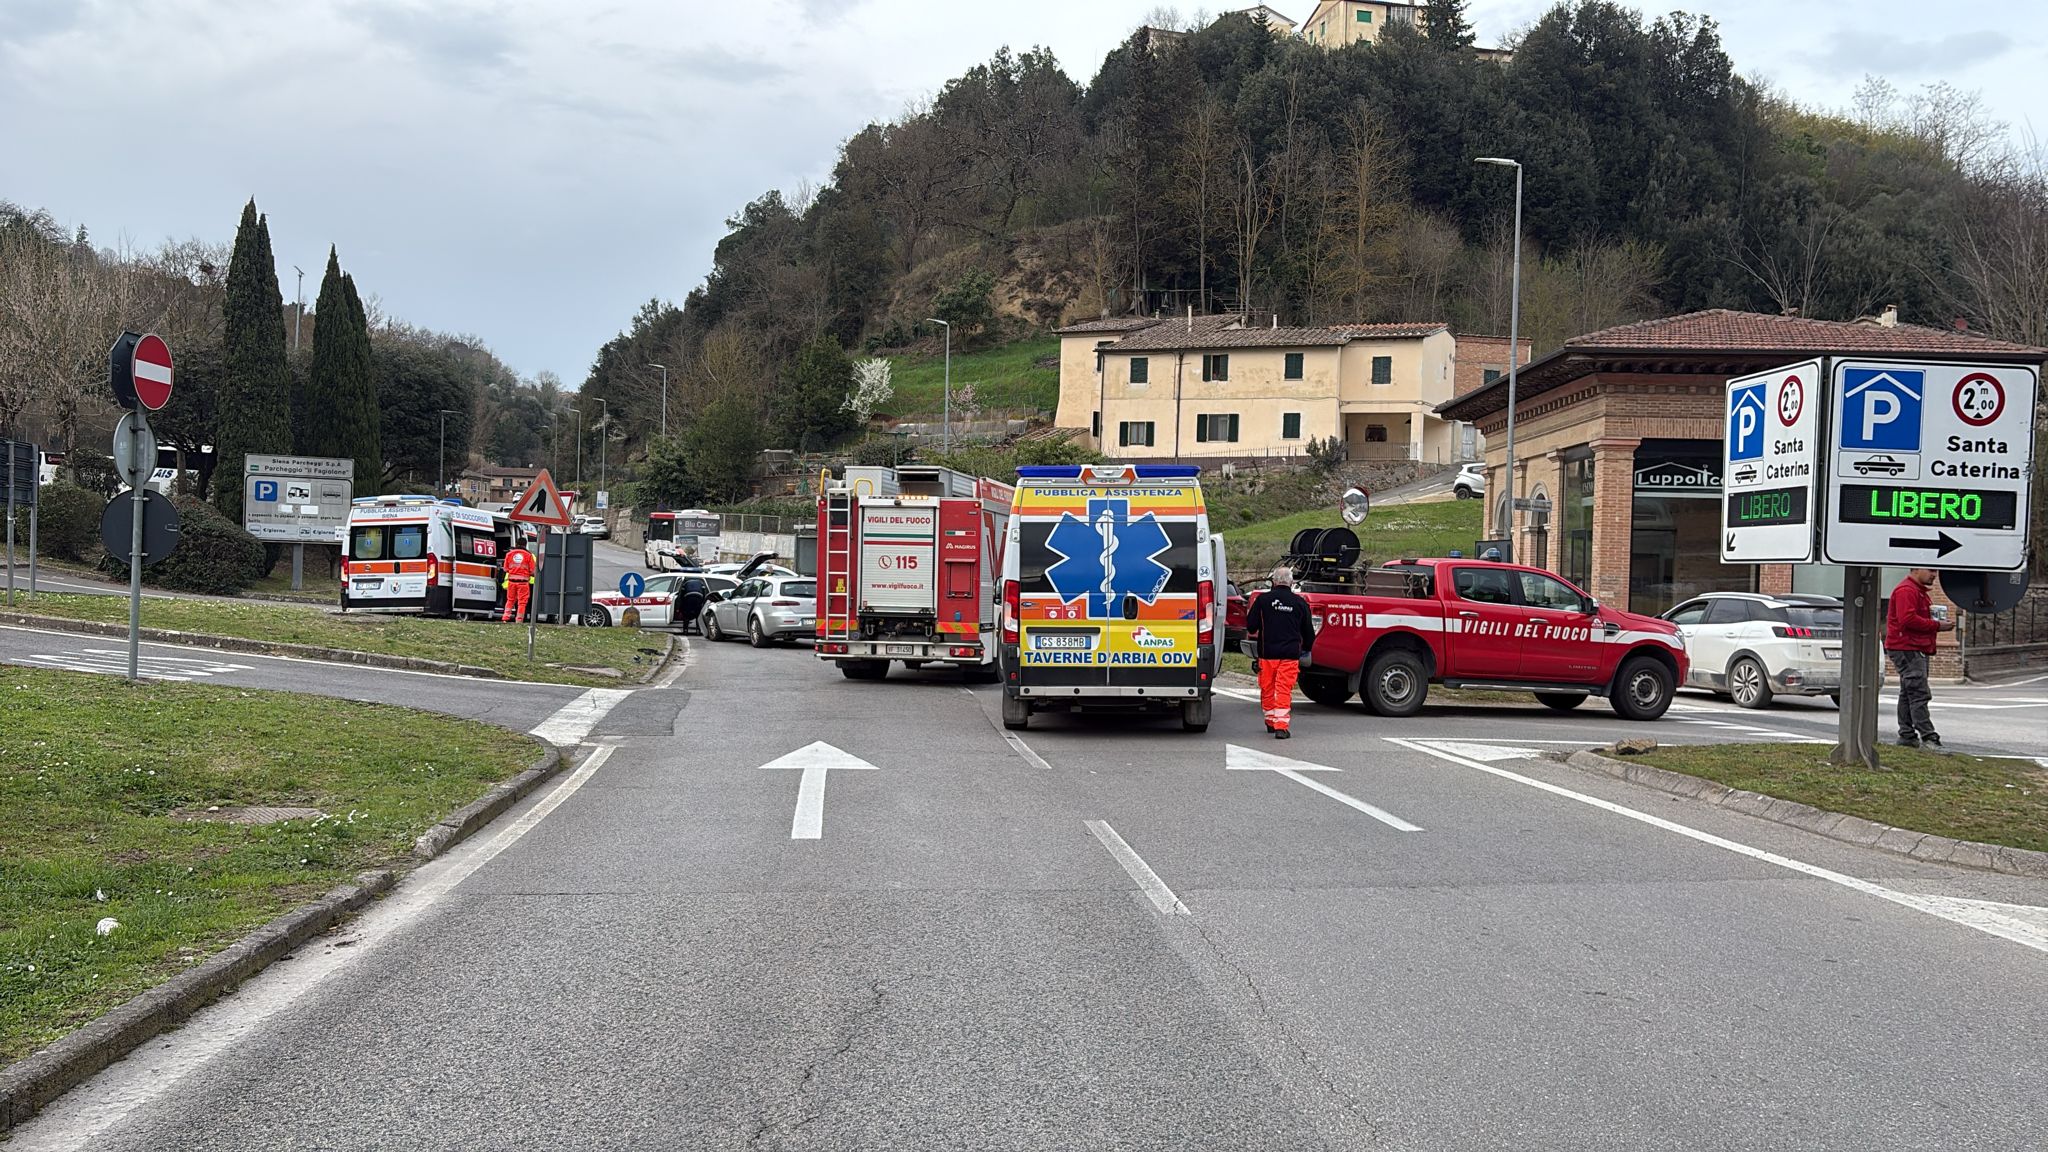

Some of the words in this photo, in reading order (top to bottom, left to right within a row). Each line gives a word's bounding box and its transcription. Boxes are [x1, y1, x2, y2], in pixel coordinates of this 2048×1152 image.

[1980, 387, 1989, 395] m
[1861, 389, 1901, 441] P
[1738, 405, 1756, 453] P
[1774, 438, 1804, 456] Santa
[1946, 435, 2008, 454] Santa
[264, 465, 303, 474] Parcheggio
[1766, 462, 1810, 480] Caterina
[1930, 460, 2020, 479] Caterina
[259, 483, 273, 499] P
[1740, 492, 1791, 520] LIBERO
[1870, 489, 1982, 521] LIBERO
[867, 516, 888, 524] VIGILI
[889, 516, 904, 524] DEL
[905, 516, 931, 525] FUOCO
[895, 555, 918, 570] 115
[1200, 568, 1209, 576] 34
[1147, 570, 1169, 603] ORION
[1341, 613, 1363, 628] 115
[1464, 619, 1510, 636] VIGILI
[1514, 623, 1539, 638] DEL
[1543, 625, 1589, 642] FUOCO
[1041, 636, 1054, 647] GS
[1024, 652, 1093, 664] TAVERNE
[1097, 652, 1159, 665] D'ARBIA
[1161, 652, 1193, 665] ODV
